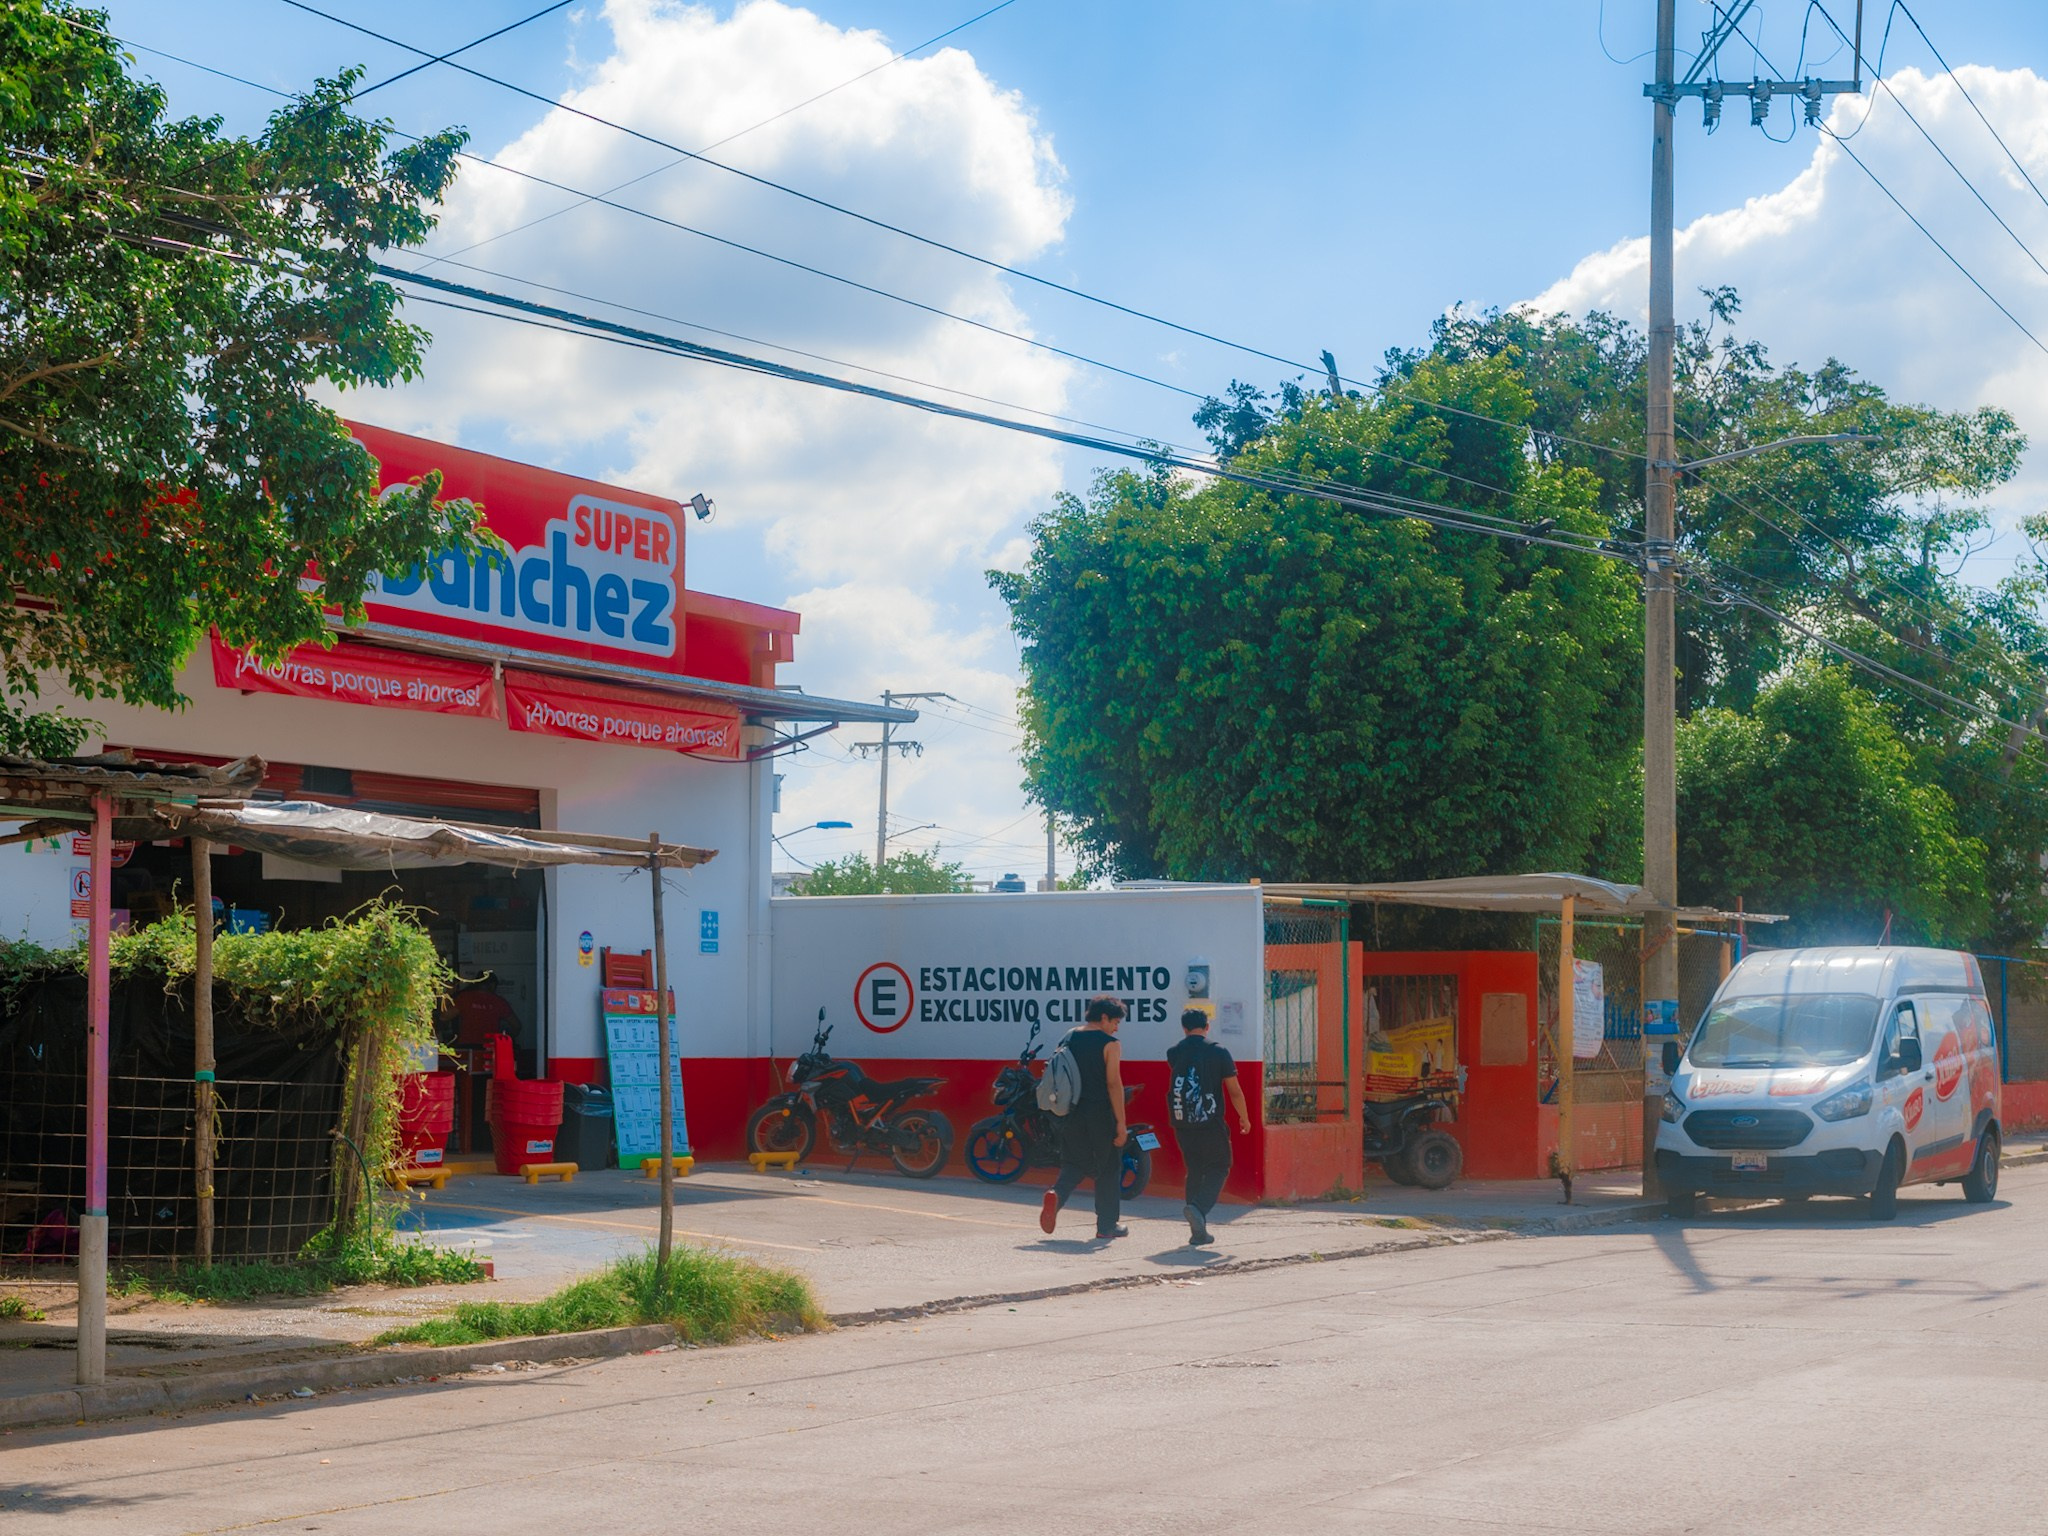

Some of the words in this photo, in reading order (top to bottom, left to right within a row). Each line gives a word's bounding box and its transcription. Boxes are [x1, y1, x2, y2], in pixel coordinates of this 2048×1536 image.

[574, 505, 670, 566] SUPER
[331, 670, 402, 699] porque
[407, 678, 480, 707] ahorras!
[525, 701, 599, 732] ¡Ahorras
[602, 716, 663, 743] porque
[665, 722, 728, 748] ahorras!
[872, 979, 896, 1016] E
[920, 966, 1171, 992] ESTACIONAMIENTO
[920, 998, 1040, 1023] EXCLUSIVO
[1046, 997, 1168, 1023] CLITES
[1173, 1076, 1185, 1120] SHAQ
